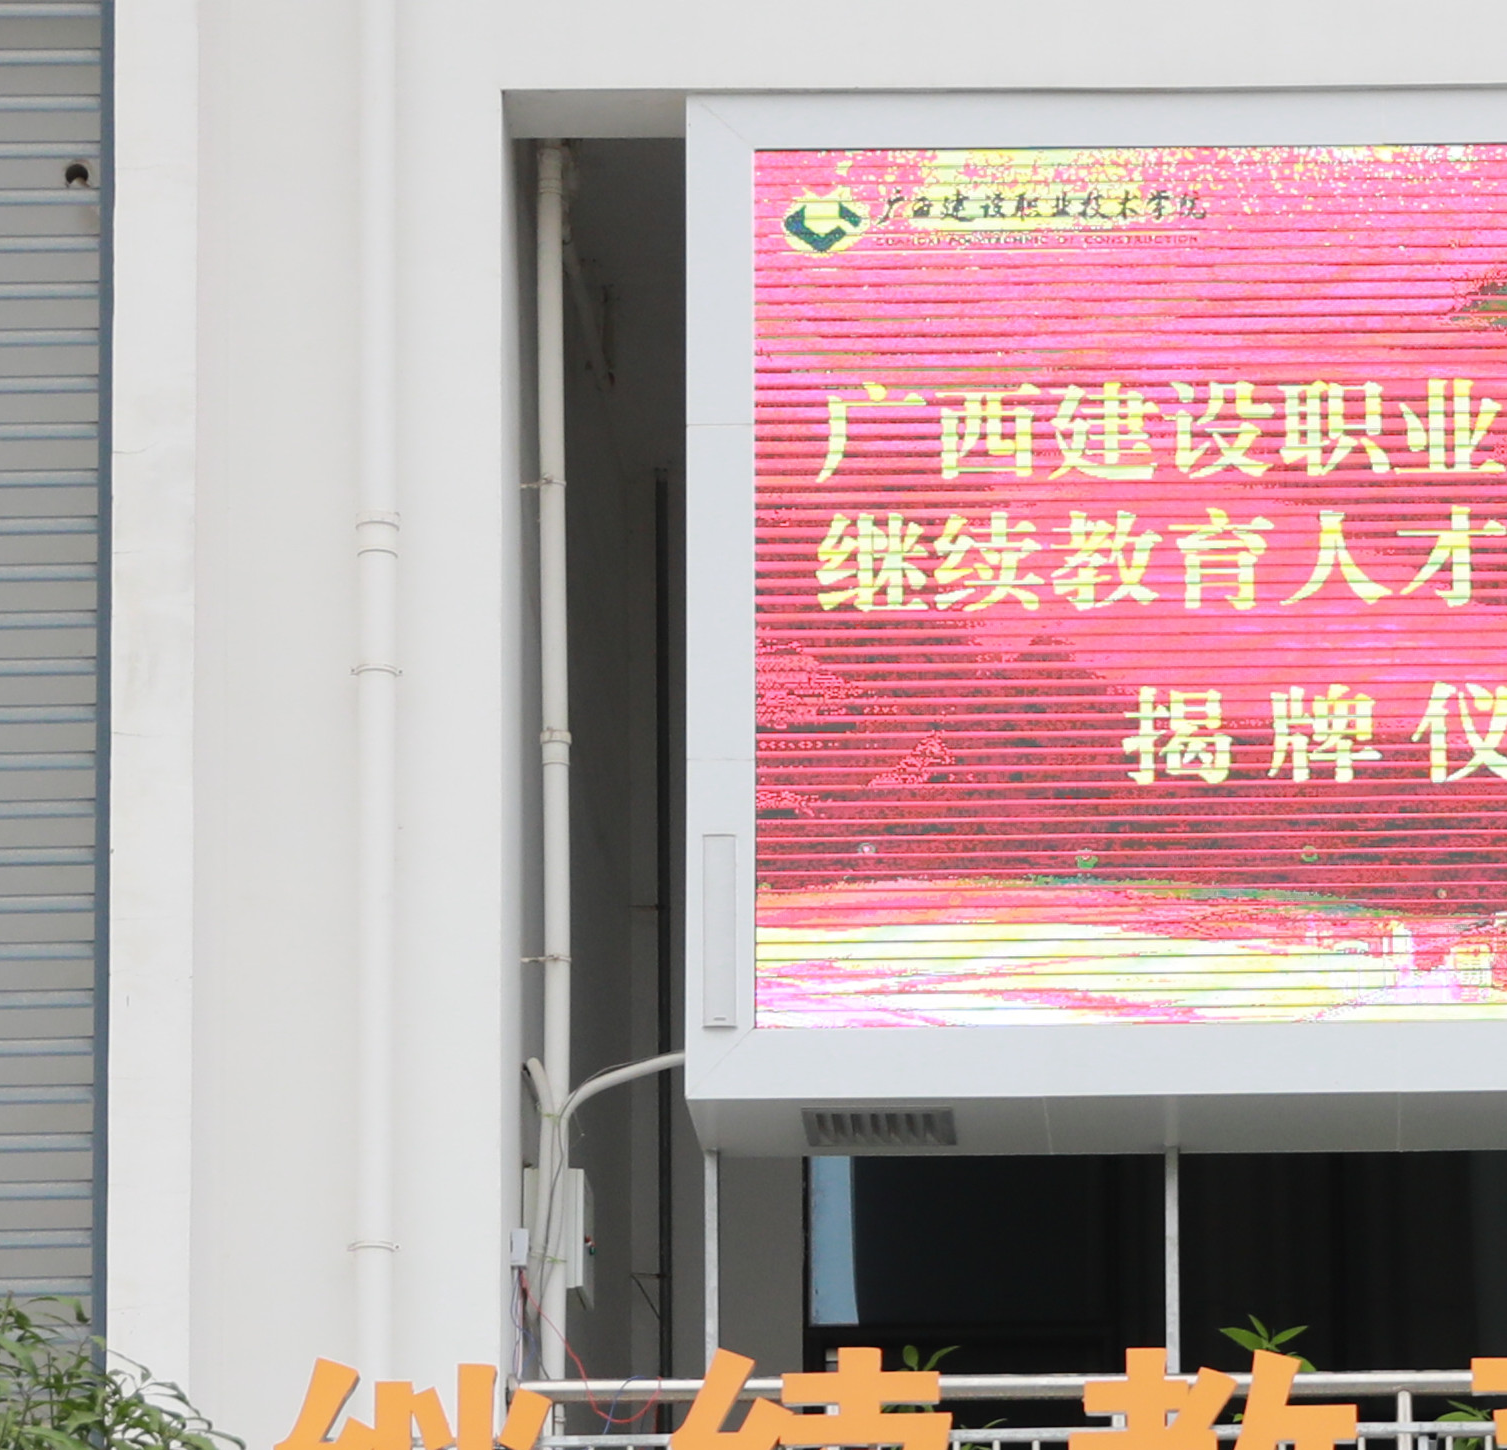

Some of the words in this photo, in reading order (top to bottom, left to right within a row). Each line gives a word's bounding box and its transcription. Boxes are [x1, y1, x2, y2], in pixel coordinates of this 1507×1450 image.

[878, 188, 1208, 226] 广西建设职业技术学院
